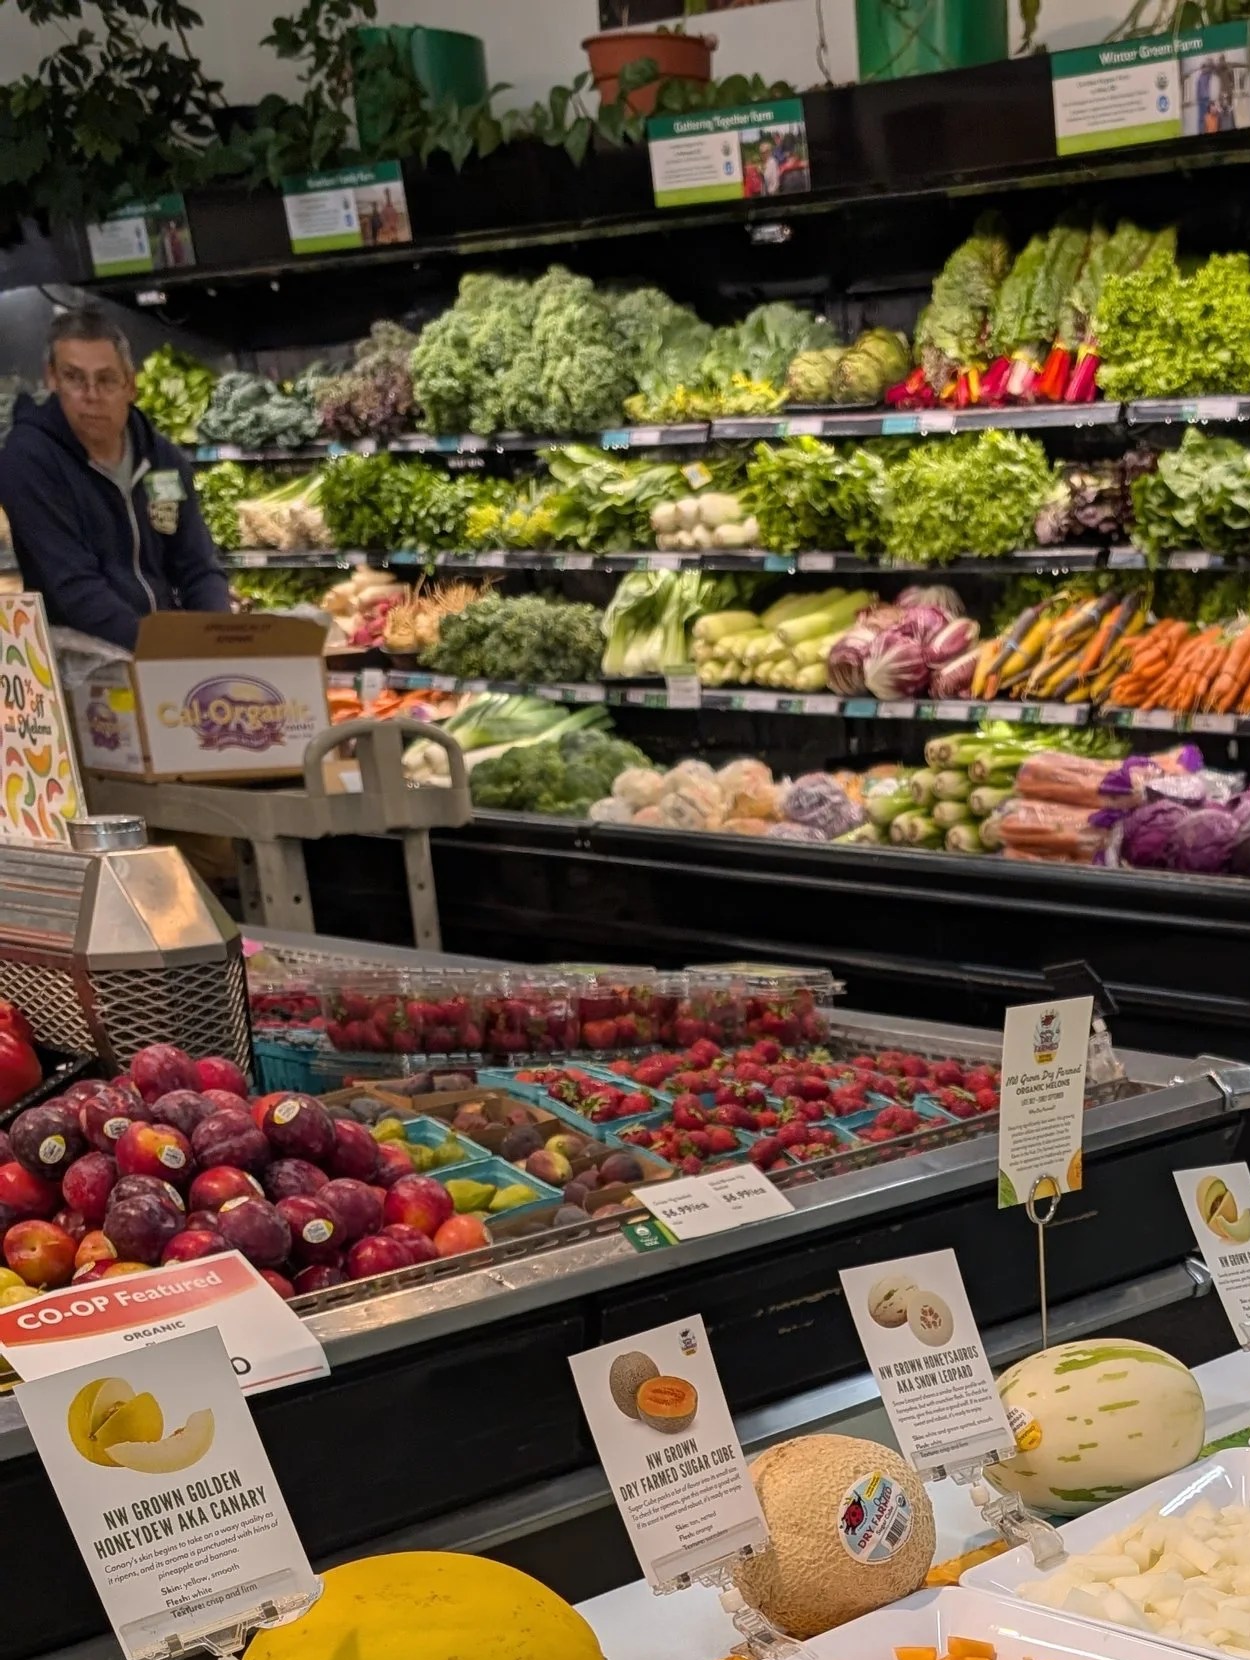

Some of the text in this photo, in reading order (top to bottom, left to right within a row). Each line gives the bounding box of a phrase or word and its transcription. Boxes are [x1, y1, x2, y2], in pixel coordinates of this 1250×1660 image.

[1099, 50, 1137, 65] Winter
[1015, 1078, 1070, 1095] ORGANIC MELONS
[17, 1271, 223, 1331] CO-OP Featured
[123, 1320, 186, 1343] ORGANIC
[893, 1357, 923, 1376] GROWN
[922, 1345, 978, 1369] HONEYSAURUS
[896, 1377, 915, 1394] AKA
[913, 1372, 938, 1389] SNOW
[937, 1364, 973, 1383] LEOPARD
[645, 1437, 698, 1470] NW GROWN
[619, 1444, 736, 1501] DRY FARMED SUGAR CUBE
[102, 1469, 242, 1530] NW GROWN GOLDEN
[93, 1485, 266, 1559] HONEYDEW AKA CANARY
[857, 1486, 893, 1549] DRY FARMED
[104, 1556, 138, 1573] Canary's
[138, 1552, 153, 1562] skin
[153, 1544, 178, 1557] begins
[186, 1535, 202, 1545] take
[219, 1522, 239, 1533] waxy
[240, 1514, 264, 1528] quality
[114, 1570, 139, 1583] ripens,
[139, 1561, 155, 1574] and
[154, 1560, 164, 1568] its
[164, 1552, 189, 1565] aroma
[196, 1533, 236, 1555] punctuated
[236, 1528, 252, 1539] with
[252, 1524, 270, 1534] hints
[157, 1547, 239, 1581] pineapple and banana.
[160, 1562, 240, 1595] Skin: yellow, smooth
[165, 1587, 212, 1607] Flesh: white
